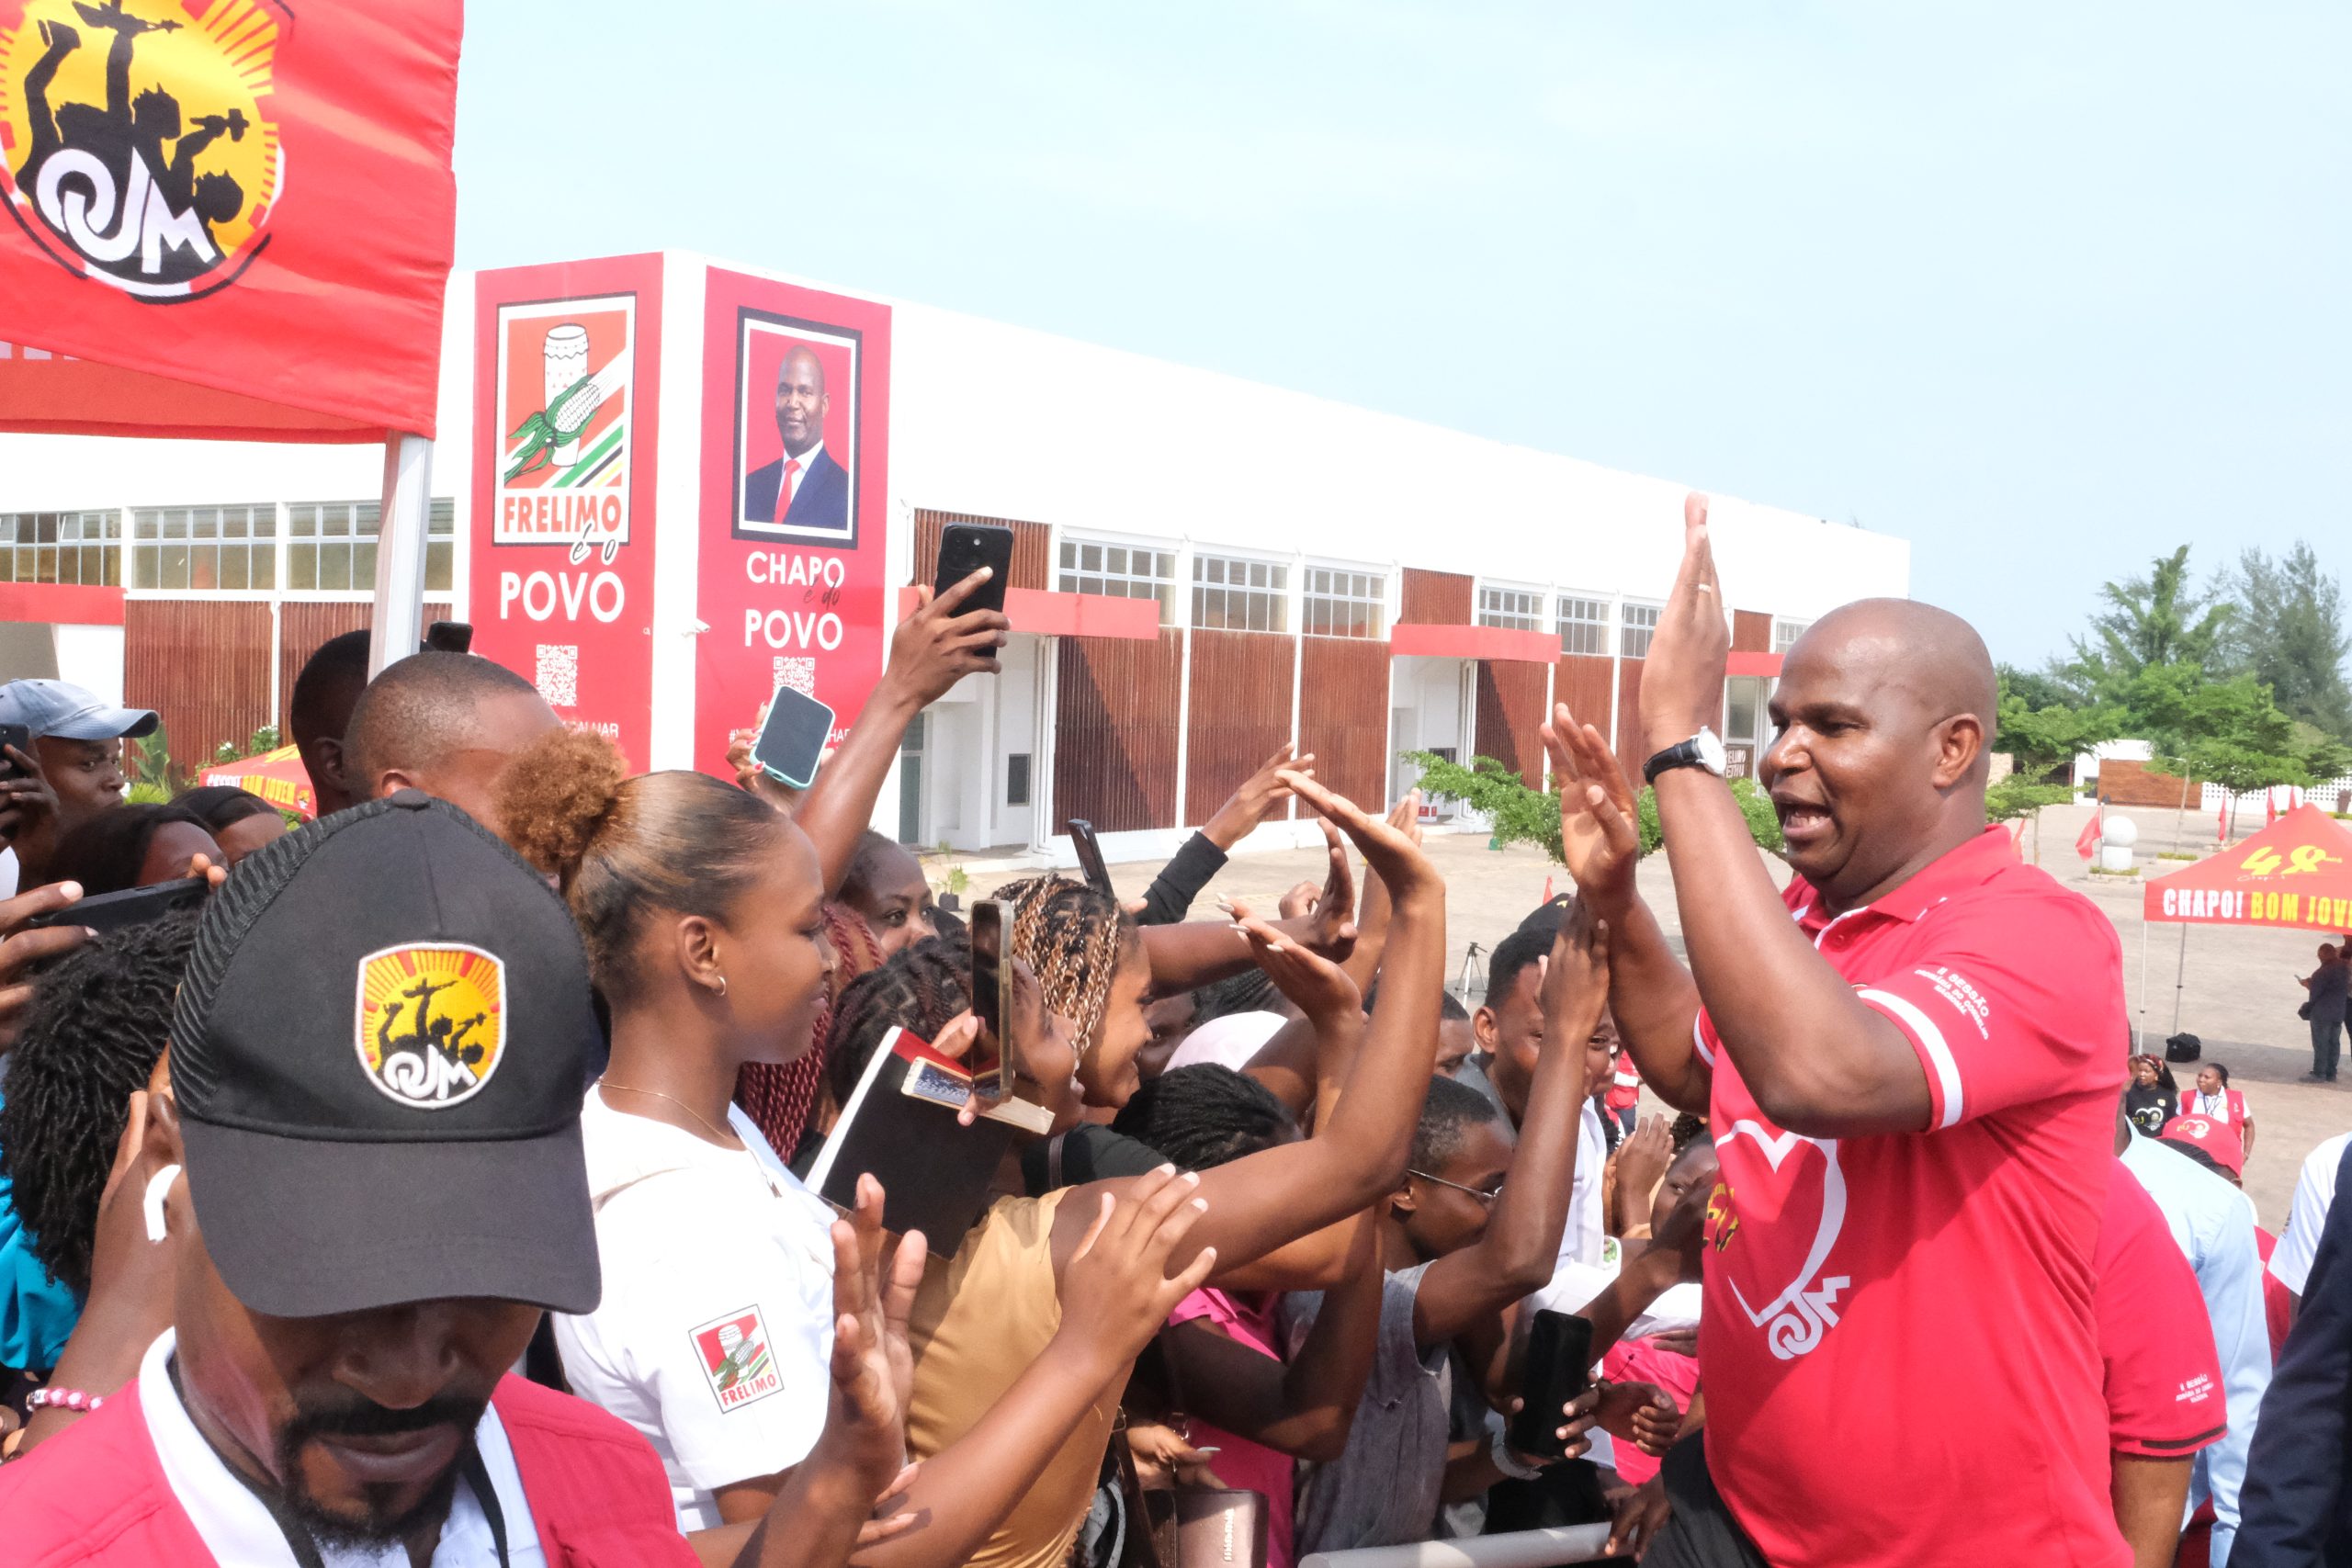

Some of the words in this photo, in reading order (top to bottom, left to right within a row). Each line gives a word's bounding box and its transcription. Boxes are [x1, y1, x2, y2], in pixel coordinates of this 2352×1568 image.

[503, 494, 622, 533] FRELIMO
[746, 551, 844, 588] CHAPO
[500, 570, 625, 623] POVO
[745, 609, 843, 651] POVO
[2163, 888, 2245, 919] CHAPO!
[2251, 891, 2300, 921] BOM
[1948, 973, 1989, 1017] SESSÃO
[720, 1373, 777, 1406] FRELIMO
